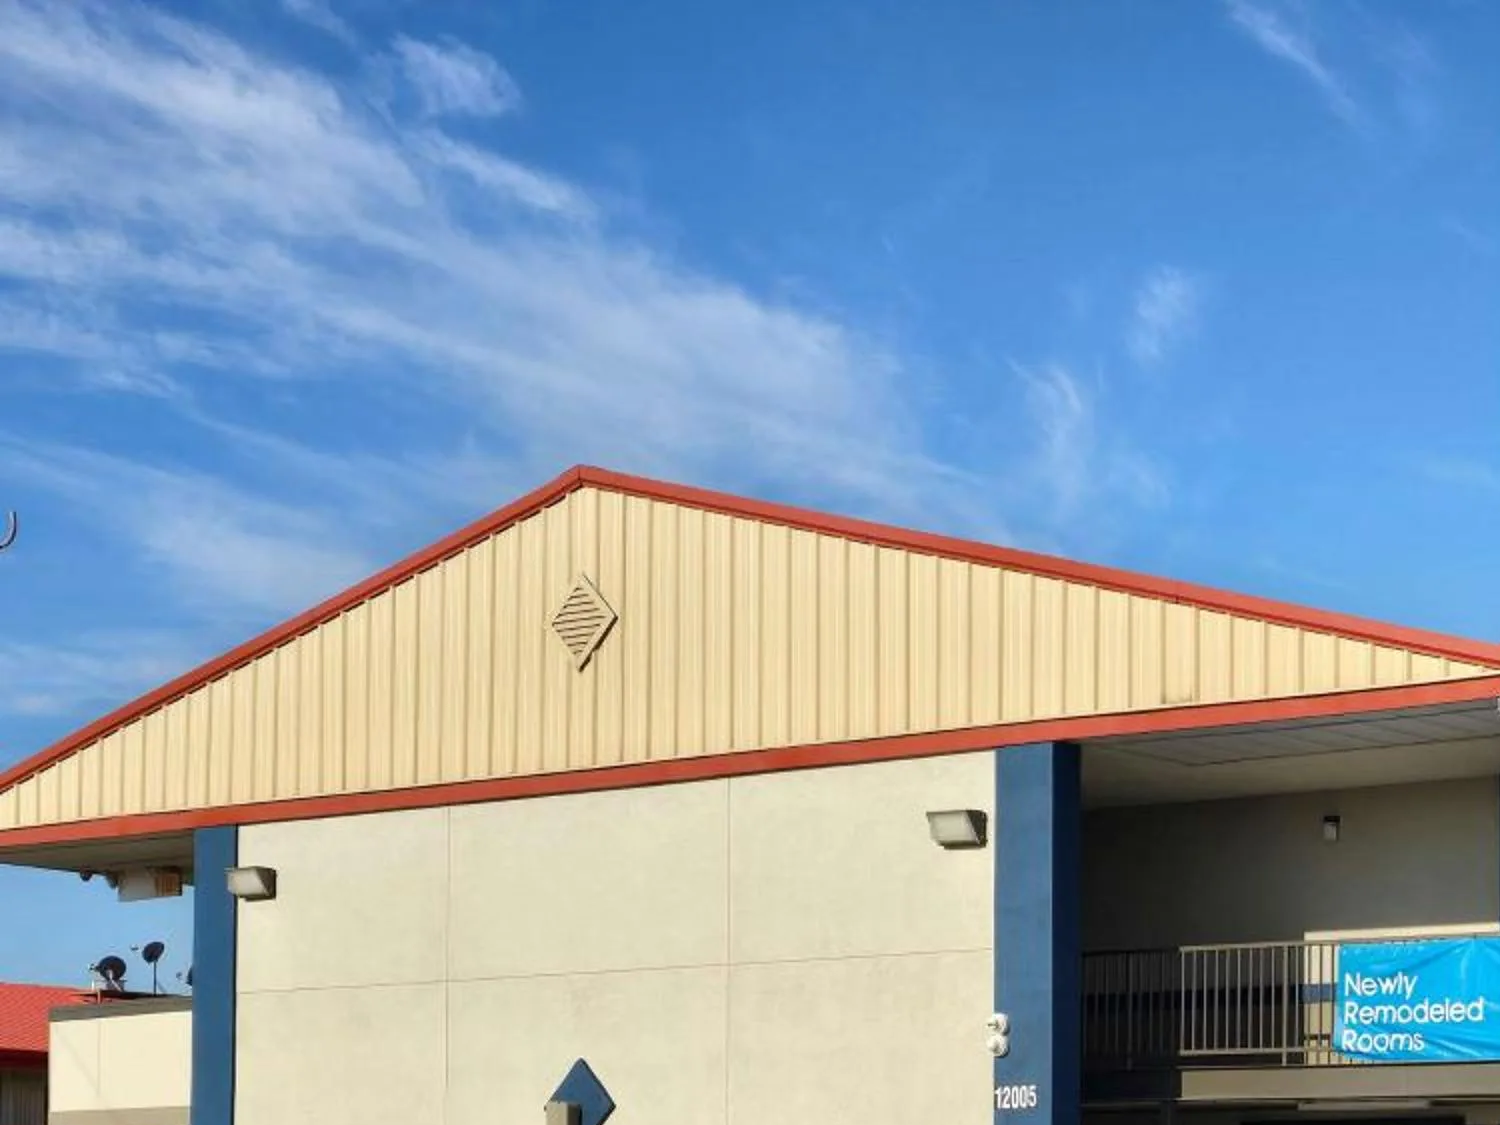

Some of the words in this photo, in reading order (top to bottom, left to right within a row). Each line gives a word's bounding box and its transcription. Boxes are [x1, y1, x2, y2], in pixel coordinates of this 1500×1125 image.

[1344, 971, 1418, 999] Newly
[1343, 996, 1485, 1025] Remodeled
[1341, 1029, 1425, 1052] Rooms
[995, 1085, 1037, 1109] 12005
